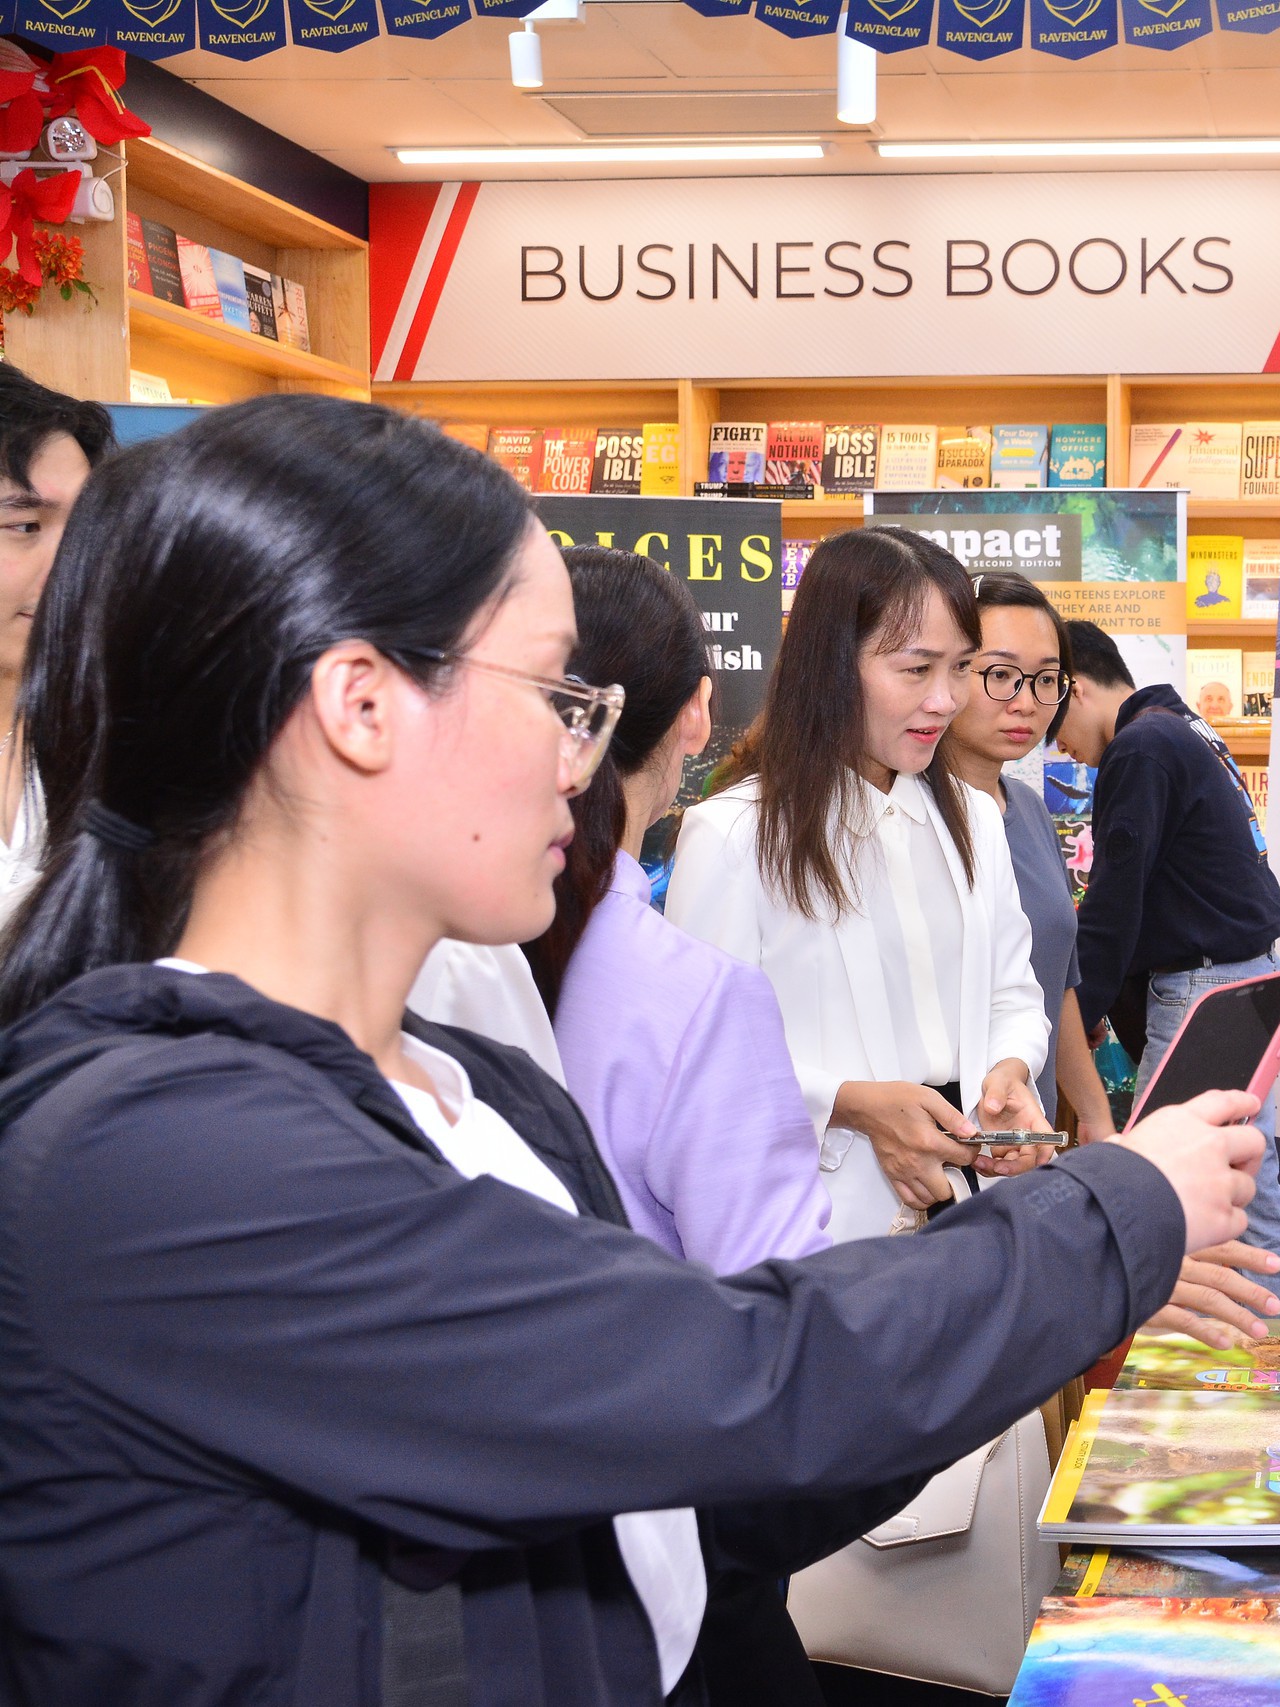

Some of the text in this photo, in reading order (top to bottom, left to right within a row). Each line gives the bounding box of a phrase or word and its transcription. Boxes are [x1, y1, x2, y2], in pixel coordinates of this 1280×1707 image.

[394, 5, 461, 28] RAVENCLAW
[764, 5, 829, 25] RAVENCLAW
[25, 20, 96, 41] RAVENCLAW
[300, 22, 369, 41] RAVENCLAW
[854, 22, 921, 39] RAVENCLAW
[1132, 18, 1202, 38] RAVENCLAW
[116, 29, 186, 45] RAVENCLAW
[208, 31, 277, 45] RAVENCLAW
[945, 30, 1013, 45] RAVENCLAW
[1039, 29, 1108, 45] RAVENCLAW
[521, 236, 1235, 301] BUSINESS BOOKS
[249, 301, 273, 317] UFFETT
[499, 436, 531, 444] DAVID
[713, 427, 764, 442] FIGHT
[776, 431, 793, 442] ALL
[887, 432, 931, 443] 15 TOOLS
[999, 429, 1039, 440] Four Days
[1010, 437, 1032, 446] Week
[494, 445, 533, 454] BROOKS
[545, 439, 567, 458] THE
[595, 436, 644, 459] POSS
[825, 432, 875, 456] POSS
[1188, 444, 1239, 456] Financial
[769, 445, 819, 459] NOTHING
[947, 449, 986, 458] SUCCESS
[543, 456, 590, 475] POWER
[834, 456, 876, 478] IBLE
[945, 458, 985, 468] PARADOX
[1187, 455, 1238, 465] Intelligence
[603, 459, 643, 481] IBLE
[552, 473, 588, 491] CODE
[1190, 551, 1238, 560] MINDMASTERS
[973, 560, 1062, 568] SECOND EDITION
[1074, 590, 1111, 600] TEENS
[1113, 589, 1166, 600] EXPLORE
[1055, 604, 1141, 613] THEY ARE AND
[1089, 618, 1126, 627] WANT
[1128, 618, 1145, 627] TO
[1147, 618, 1161, 627] BE
